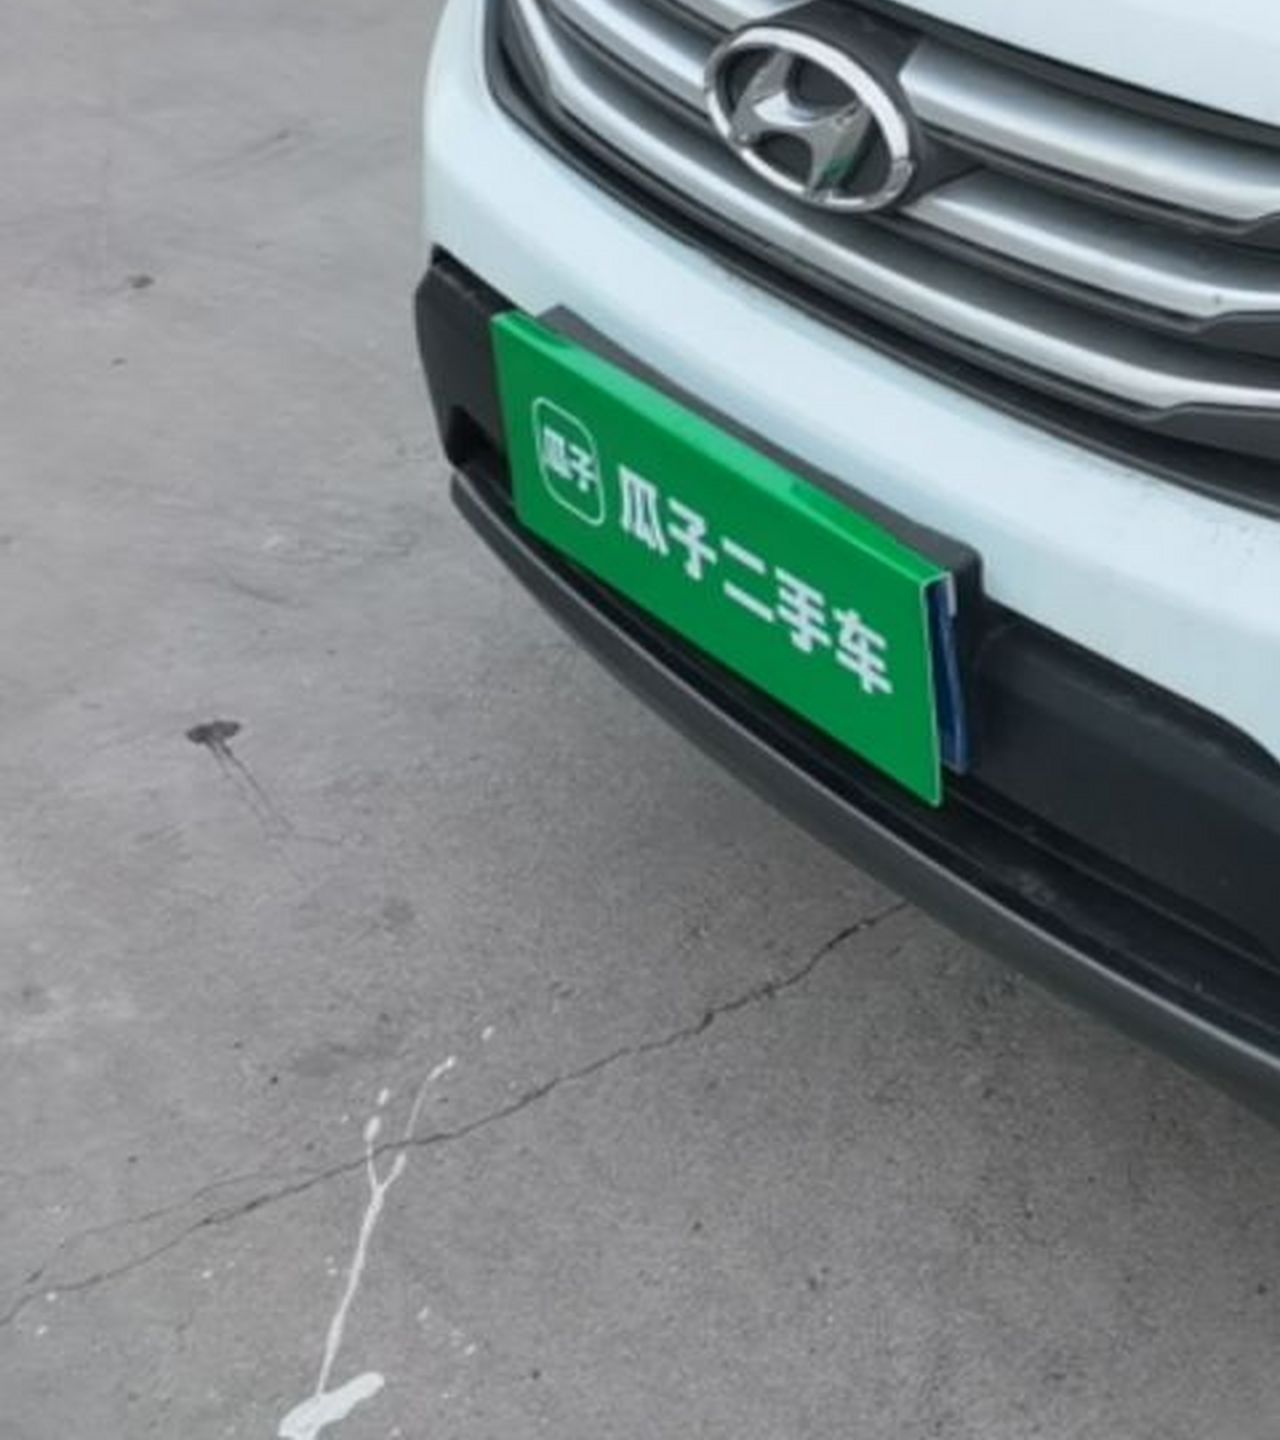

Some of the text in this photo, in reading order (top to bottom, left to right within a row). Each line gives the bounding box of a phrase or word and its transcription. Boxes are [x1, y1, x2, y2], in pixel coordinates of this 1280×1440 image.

[541, 425, 598, 495] 瓜子
[617, 464, 893, 694] 瓜子二手车
